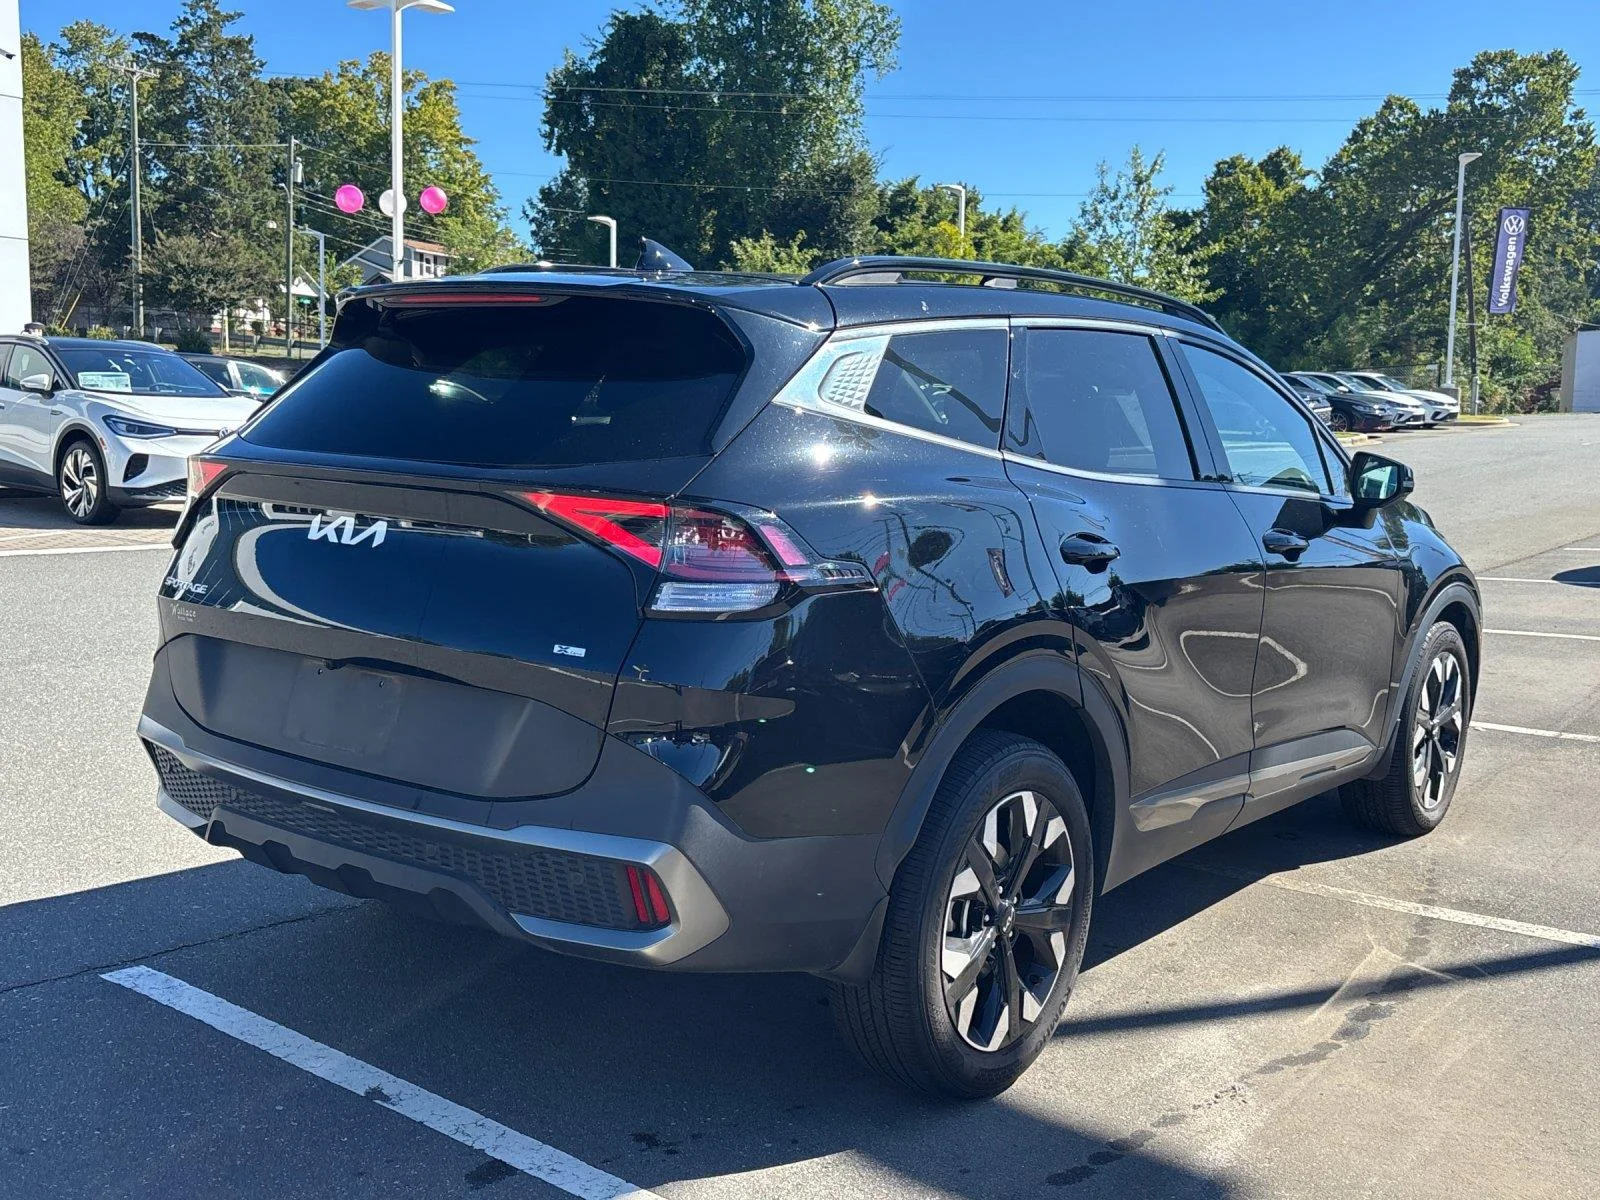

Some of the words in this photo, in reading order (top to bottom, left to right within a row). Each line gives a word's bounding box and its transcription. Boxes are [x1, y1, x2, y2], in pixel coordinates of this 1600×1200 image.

[1497, 236, 1517, 307] Volkswagen
[307, 513, 388, 548] KIA
[164, 576, 209, 594] SPORTAGE
